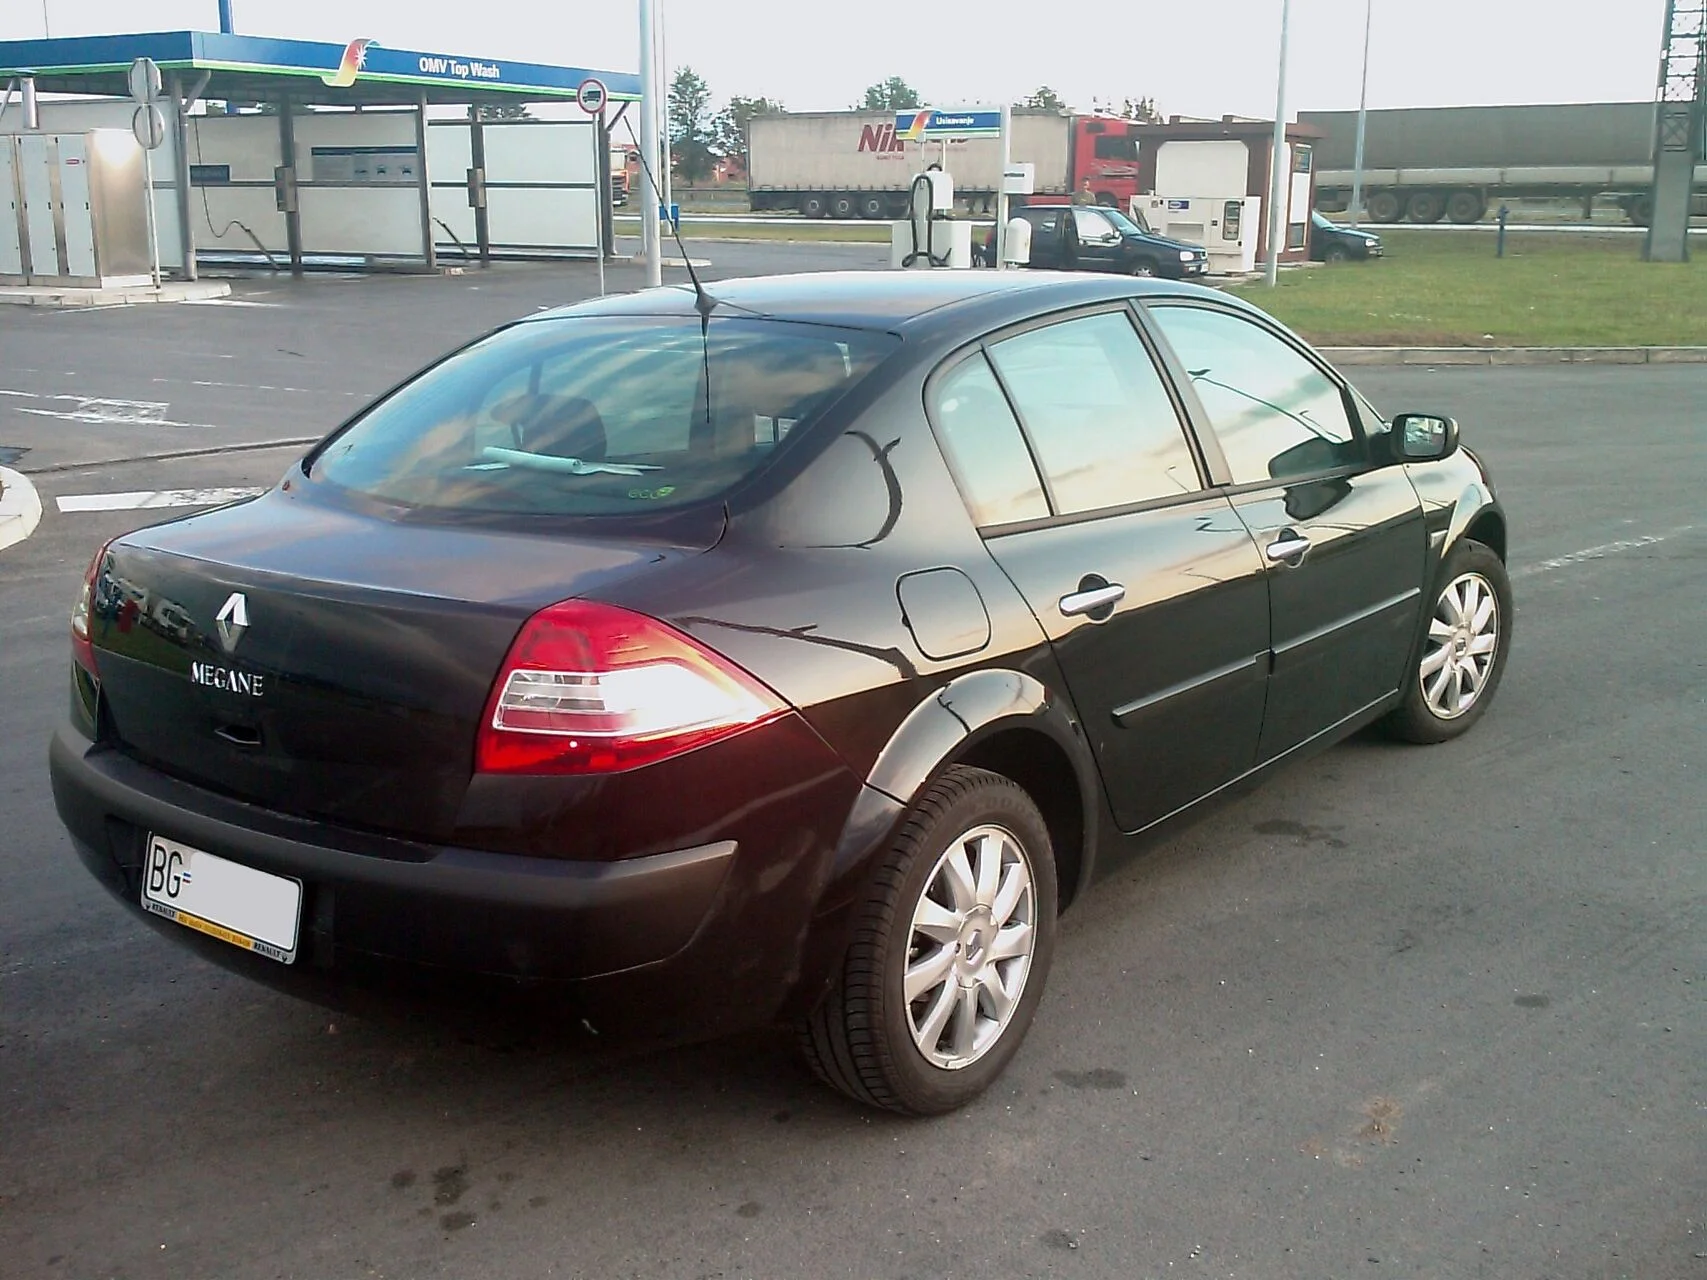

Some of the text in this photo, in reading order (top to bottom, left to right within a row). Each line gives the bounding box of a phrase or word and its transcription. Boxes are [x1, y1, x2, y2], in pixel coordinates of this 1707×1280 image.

[419, 57, 500, 78] OMV Top Wash
[191, 661, 264, 696] MEGANE
[149, 844, 183, 898] BG
[254, 942, 280, 957] RENAULT
